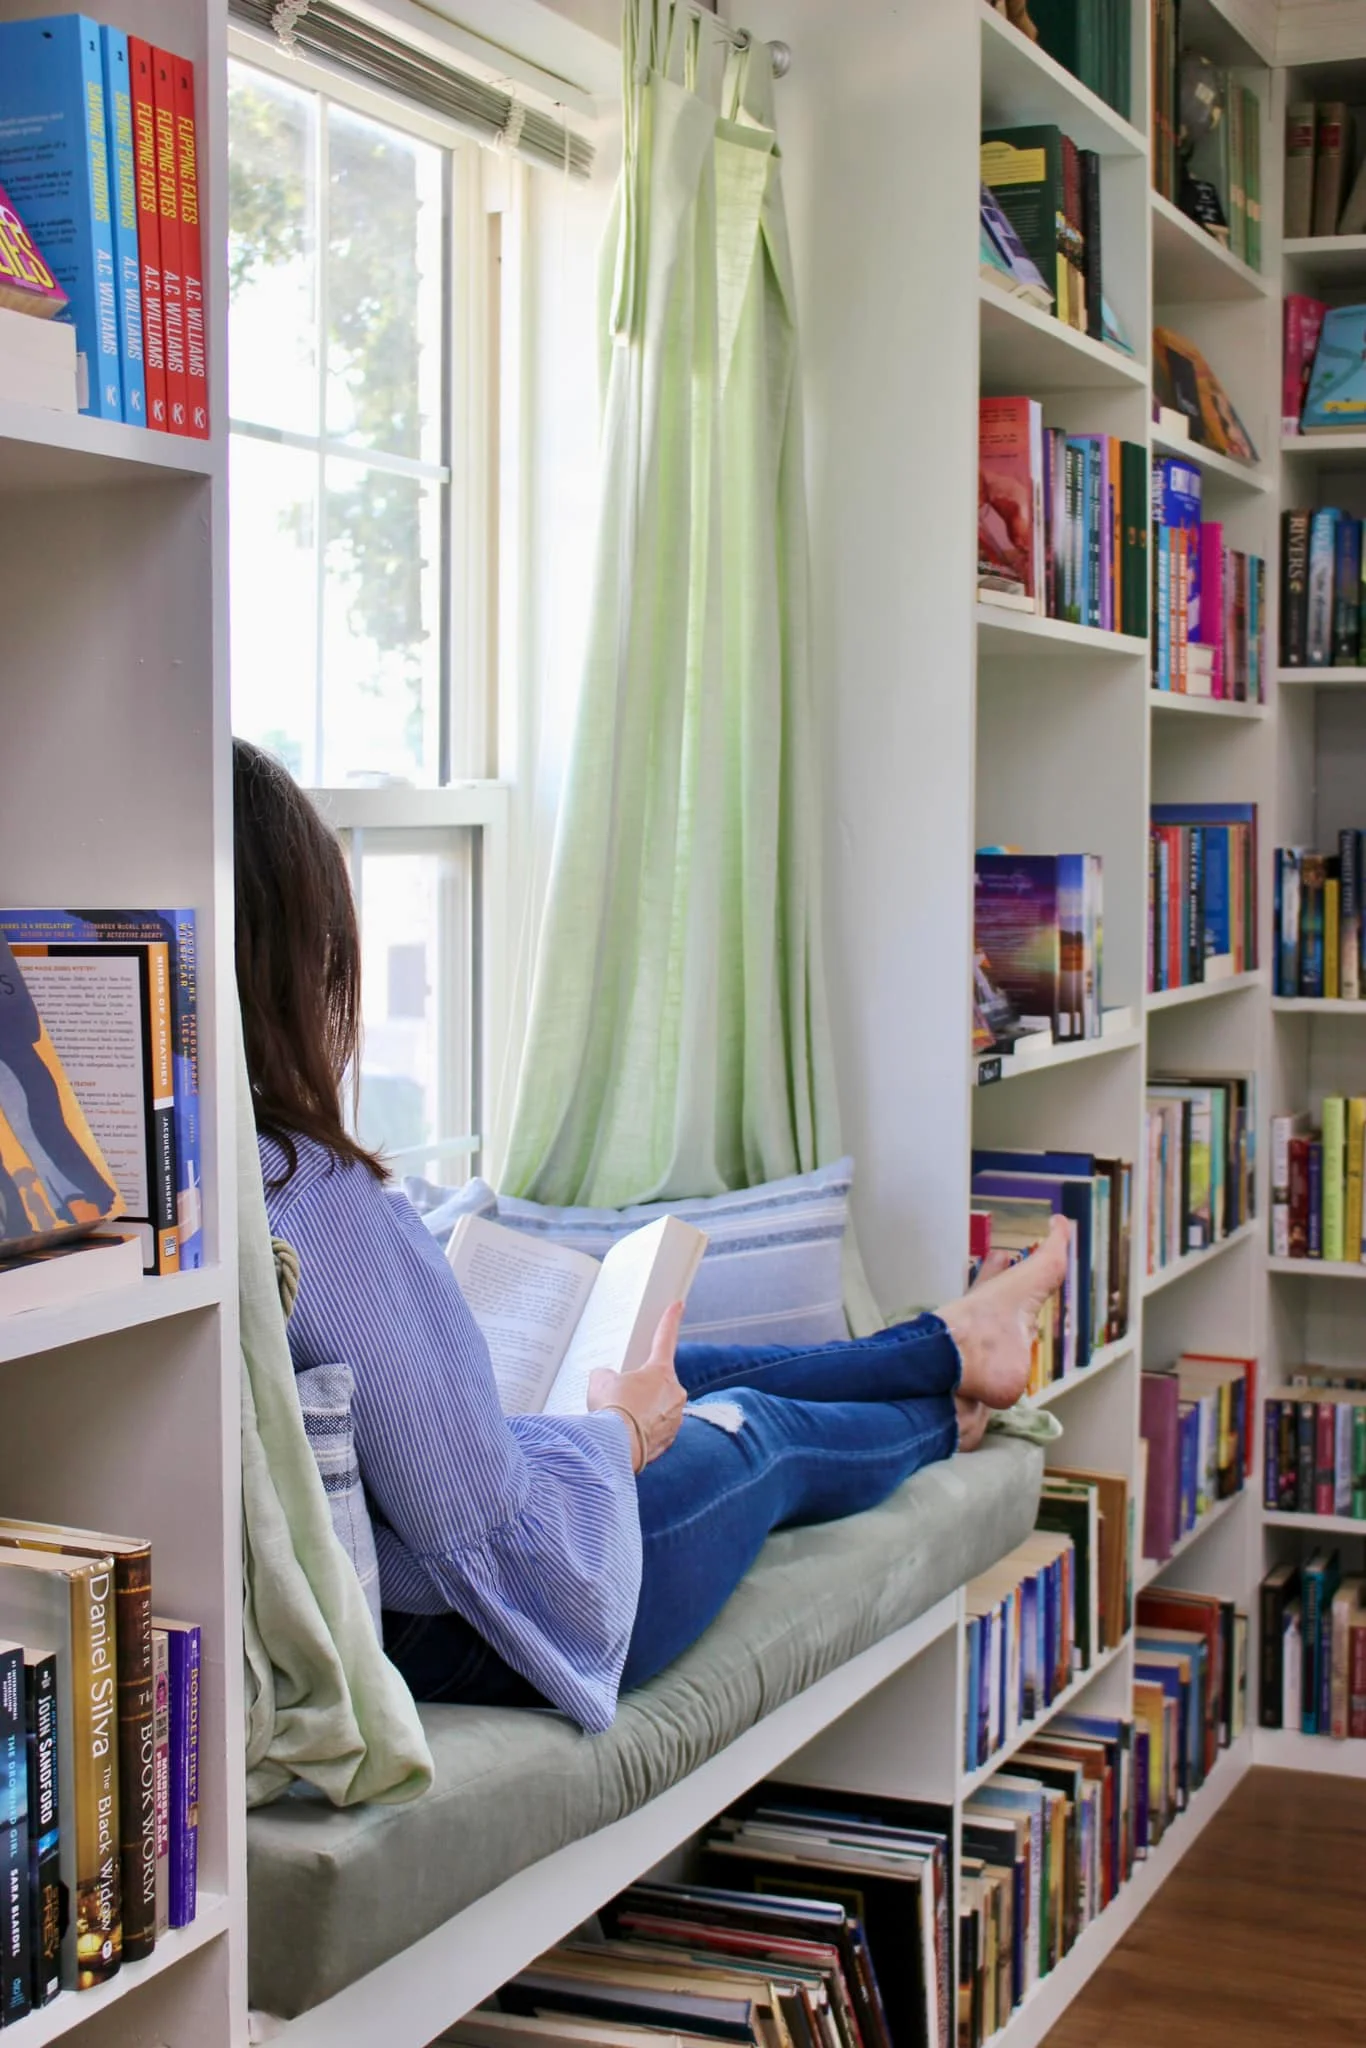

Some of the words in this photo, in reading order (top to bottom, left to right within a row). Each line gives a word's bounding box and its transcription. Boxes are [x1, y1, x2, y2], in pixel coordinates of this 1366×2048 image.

[87, 82, 104, 133] SAVING
[115, 91, 133, 145] SAVING
[137, 102, 153, 165] FLIPPING
[157, 108, 173, 172] FLIPPING
[178, 116, 195, 179] FLIPPING
[90, 140, 110, 222] SPARROWS
[119, 149, 136, 229] SPARROWS
[140, 169, 156, 212] FATES
[160, 176, 176, 218] FATES
[182, 182, 197, 224] FATES
[97, 249, 113, 274] A.C.
[124, 256, 138, 281] A.C.
[144, 265, 160, 291] A.C.
[164, 270, 181, 295] A.C.
[185, 276, 202, 301] A.C.
[99, 282, 117, 355] WILLIAMS
[125, 288, 142, 360] WILLIAMS
[146, 297, 163, 368] WILLIAMS
[166, 302, 183, 373] WILLIAMS
[186, 307, 204, 376] WILLIAMS
[1289, 517, 1305, 578] RIVERS
[179, 922, 187, 986] WINSPEAR
[187, 923, 195, 1001] JACQUELINE
[158, 998, 165, 1015] OF
[159, 1018, 166, 1027] A
[181, 1015, 189, 1044] LIES
[89, 1573, 112, 1675] Daniel
[142, 1601, 151, 1668] SILVER
[37, 1695, 52, 1737] JOHN
[91, 1679, 113, 1759] Silva
[190, 1668, 198, 1748] BORDER
[7, 1735, 16, 1758] THE
[8, 1762, 17, 1824] DROWNED
[39, 1741, 53, 1824] SANDFORD
[103, 1765, 112, 1790] The
[9, 1829, 18, 1858] GIRL
[98, 1796, 113, 1855] Black
[11, 1869, 19, 1903] SARA
[100, 1858, 114, 1931] Widow
[11, 1907, 20, 1957] BLAEDEL
[42, 1885, 54, 1959] PREY
